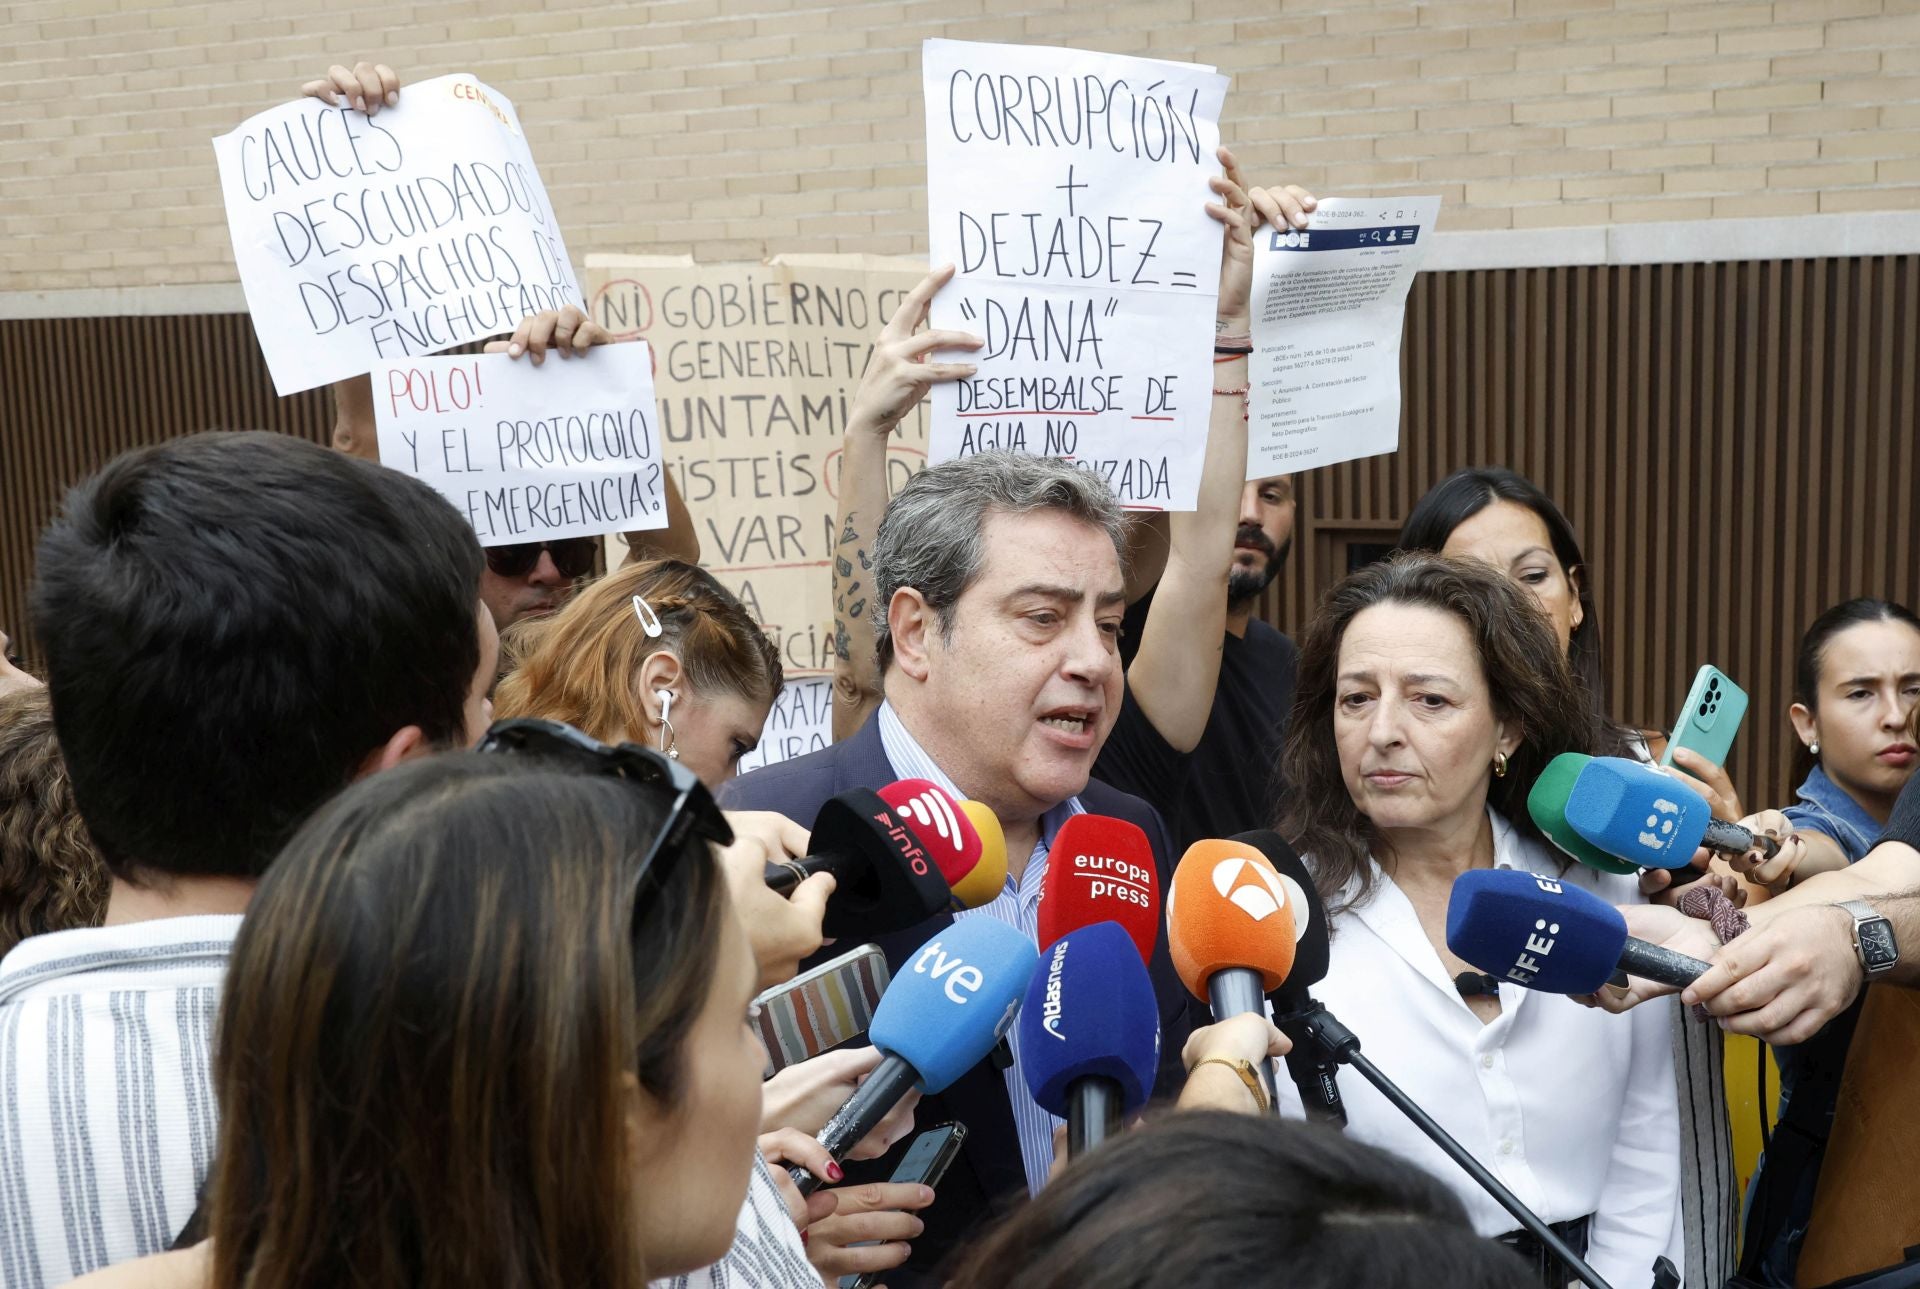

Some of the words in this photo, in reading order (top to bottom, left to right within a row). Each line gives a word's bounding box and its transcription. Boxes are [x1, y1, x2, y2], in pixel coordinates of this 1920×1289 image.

[949, 68, 1199, 165] CORRUPCIÓN
[242, 107, 402, 201] CAUCES
[959, 211, 1163, 285] DEJADEZ
[1275, 232, 1310, 248] BOE
[298, 227, 521, 334] DESPACHOS
[389, 362, 484, 418] POLO!
[957, 375, 1124, 413] DESEMBALSE
[1145, 376, 1177, 414] DE
[1312, 378, 1344, 389] Contratación
[401, 430, 419, 473] Y
[442, 430, 484, 474] EL
[497, 409, 651, 473] PROTOCOLO
[959, 421, 1027, 460] AGUA
[1044, 419, 1078, 456] NO
[1272, 419, 1298, 428] Ministerio
[1284, 426, 1318, 436] Demográfico
[467, 463, 661, 537] EMERGENCIA?
[888, 826, 929, 876] info
[1075, 854, 1150, 884] europa
[1091, 880, 1150, 908] press
[914, 941, 984, 1005] tve
[1323, 1075, 1335, 1100] MEDIA
